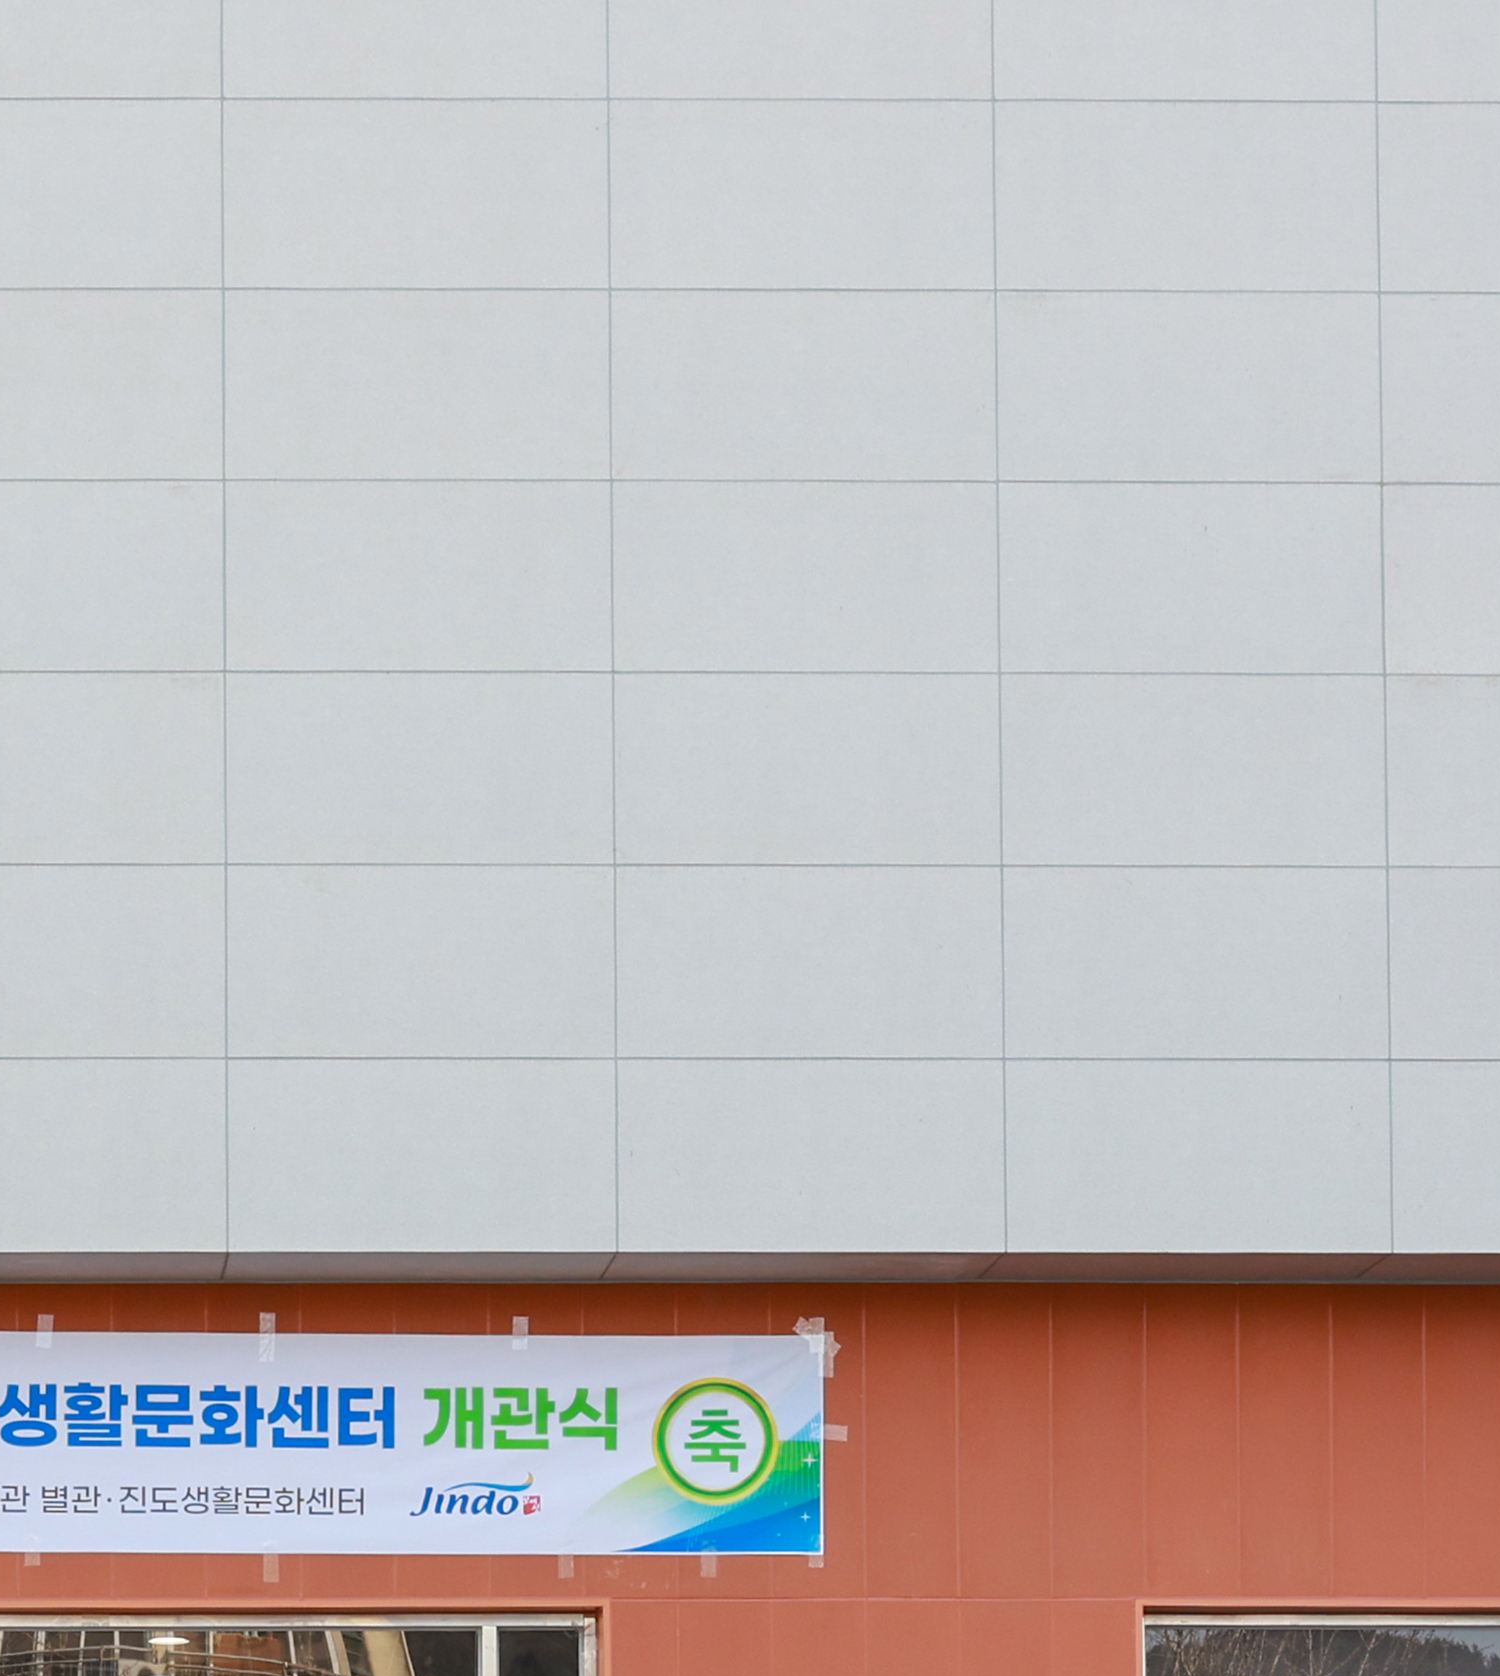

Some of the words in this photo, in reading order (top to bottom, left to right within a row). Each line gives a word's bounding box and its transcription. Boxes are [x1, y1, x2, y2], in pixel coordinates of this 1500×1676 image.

[423, 1386, 618, 1451] 개관식
[683, 1408, 746, 1473] 축
[409, 1486, 519, 1517] Jindo
